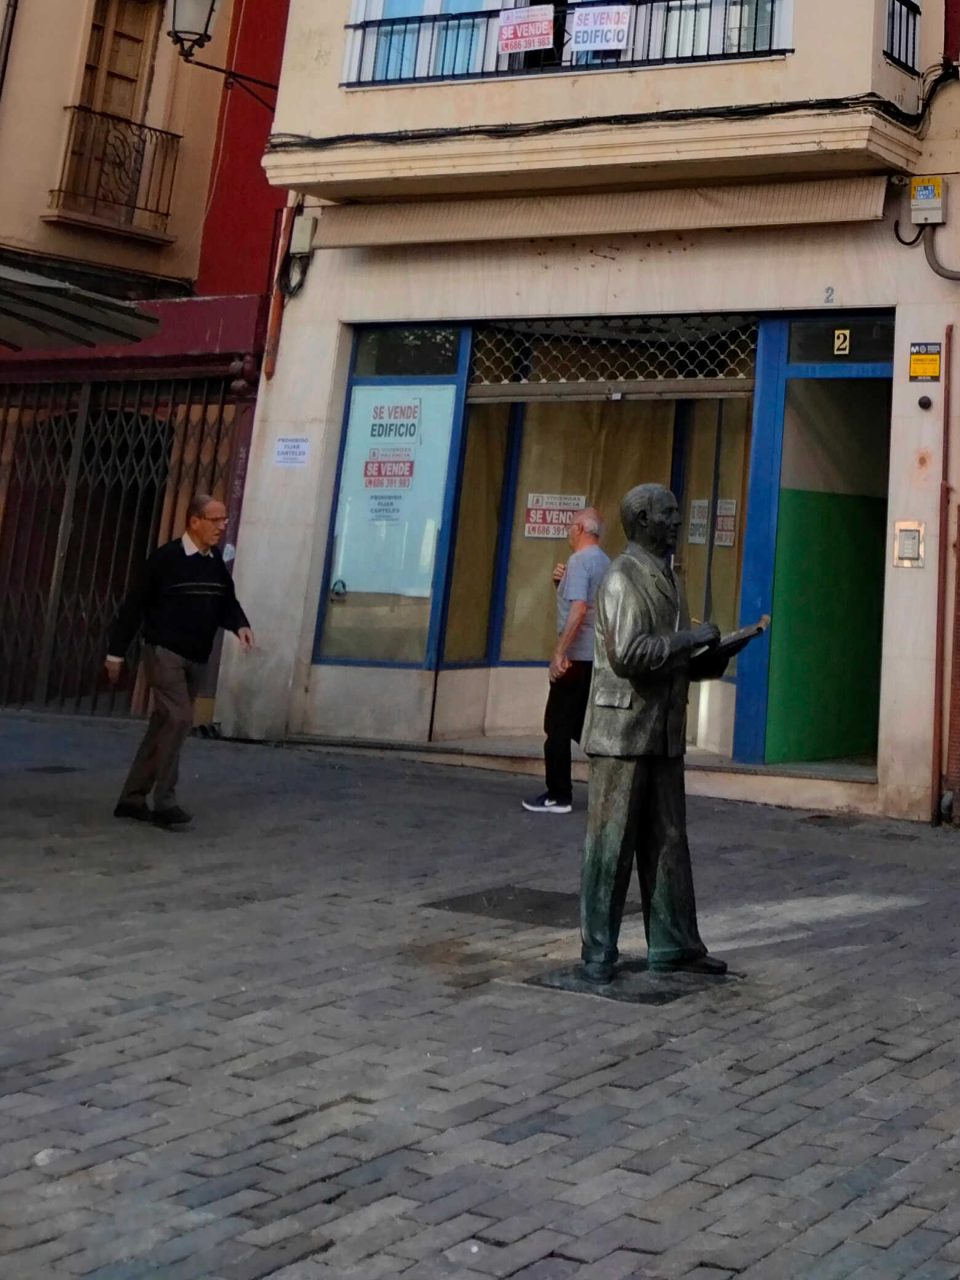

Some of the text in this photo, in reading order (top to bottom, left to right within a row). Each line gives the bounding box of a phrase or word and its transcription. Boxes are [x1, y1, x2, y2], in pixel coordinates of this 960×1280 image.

[576, 11, 627, 27] SE VENDE
[501, 21, 549, 39] SE VENDE
[574, 29, 625, 45] EDIFICIO
[824, 286, 834, 304] 2
[836, 332, 848, 351] 2
[372, 405, 418, 420] SE VENDE
[370, 422, 417, 438] EDIFICIO
[366, 462, 411, 476] SE VENDE
[529, 509, 543, 523] SE
